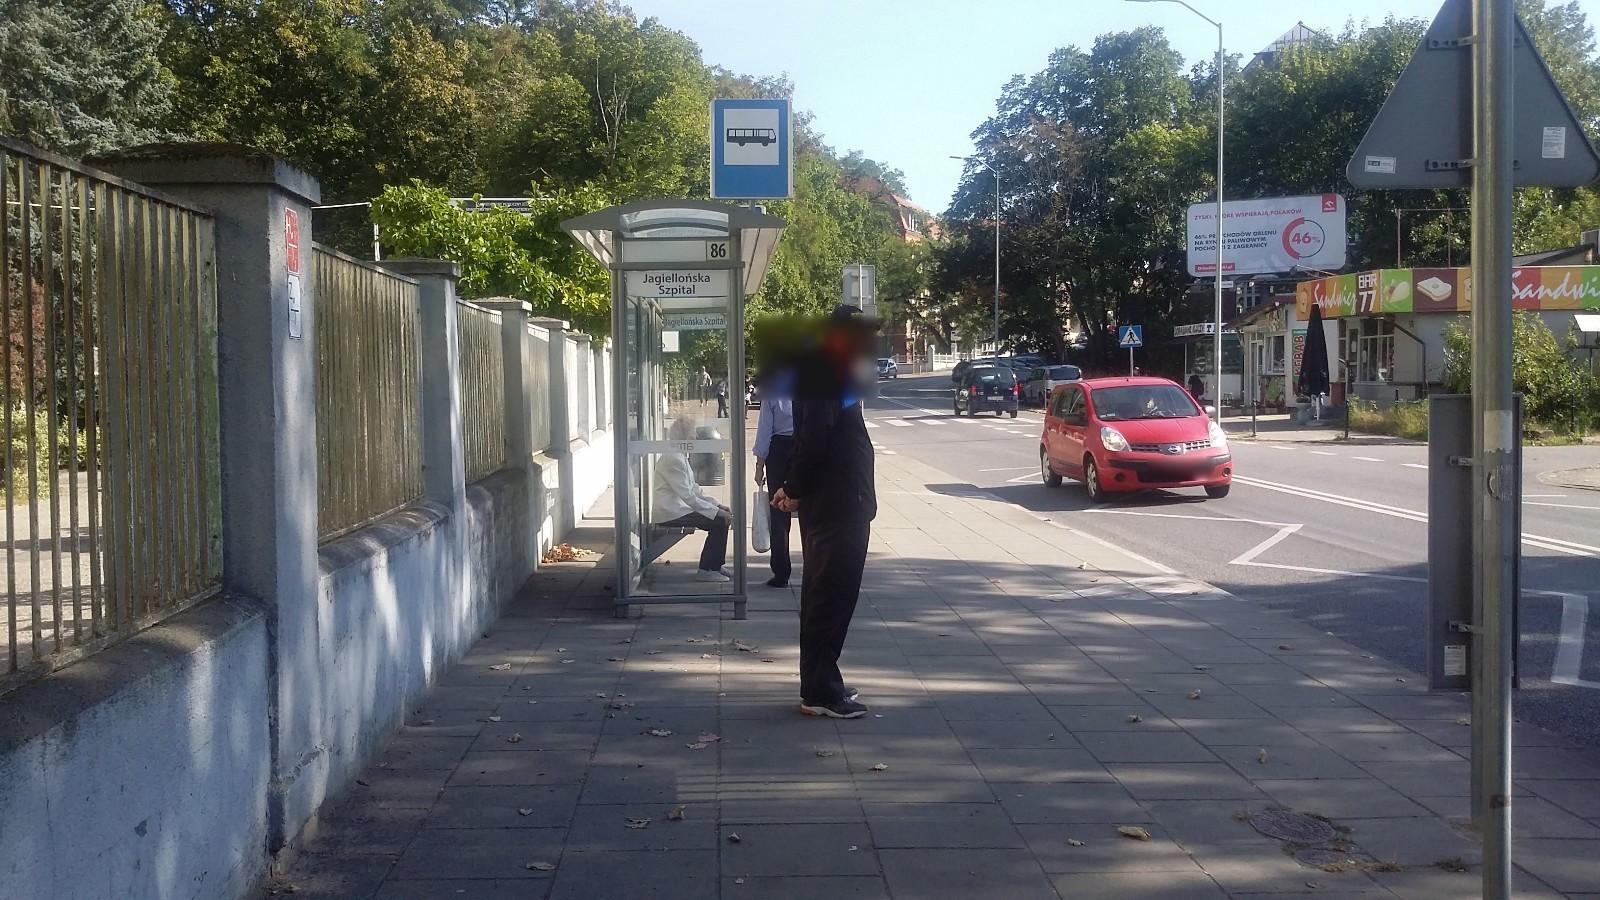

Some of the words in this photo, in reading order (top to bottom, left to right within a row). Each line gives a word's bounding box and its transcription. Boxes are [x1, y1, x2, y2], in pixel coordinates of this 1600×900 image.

[1252, 229, 1277, 237] ORLENU
[710, 243, 726, 258] 86
[642, 273, 711, 286] Jagiellońska
[1358, 273, 1377, 289] BAR
[658, 284, 696, 297] Szpital
[1358, 290, 1377, 313] 77
[1293, 335, 1304, 377] KEBAB
